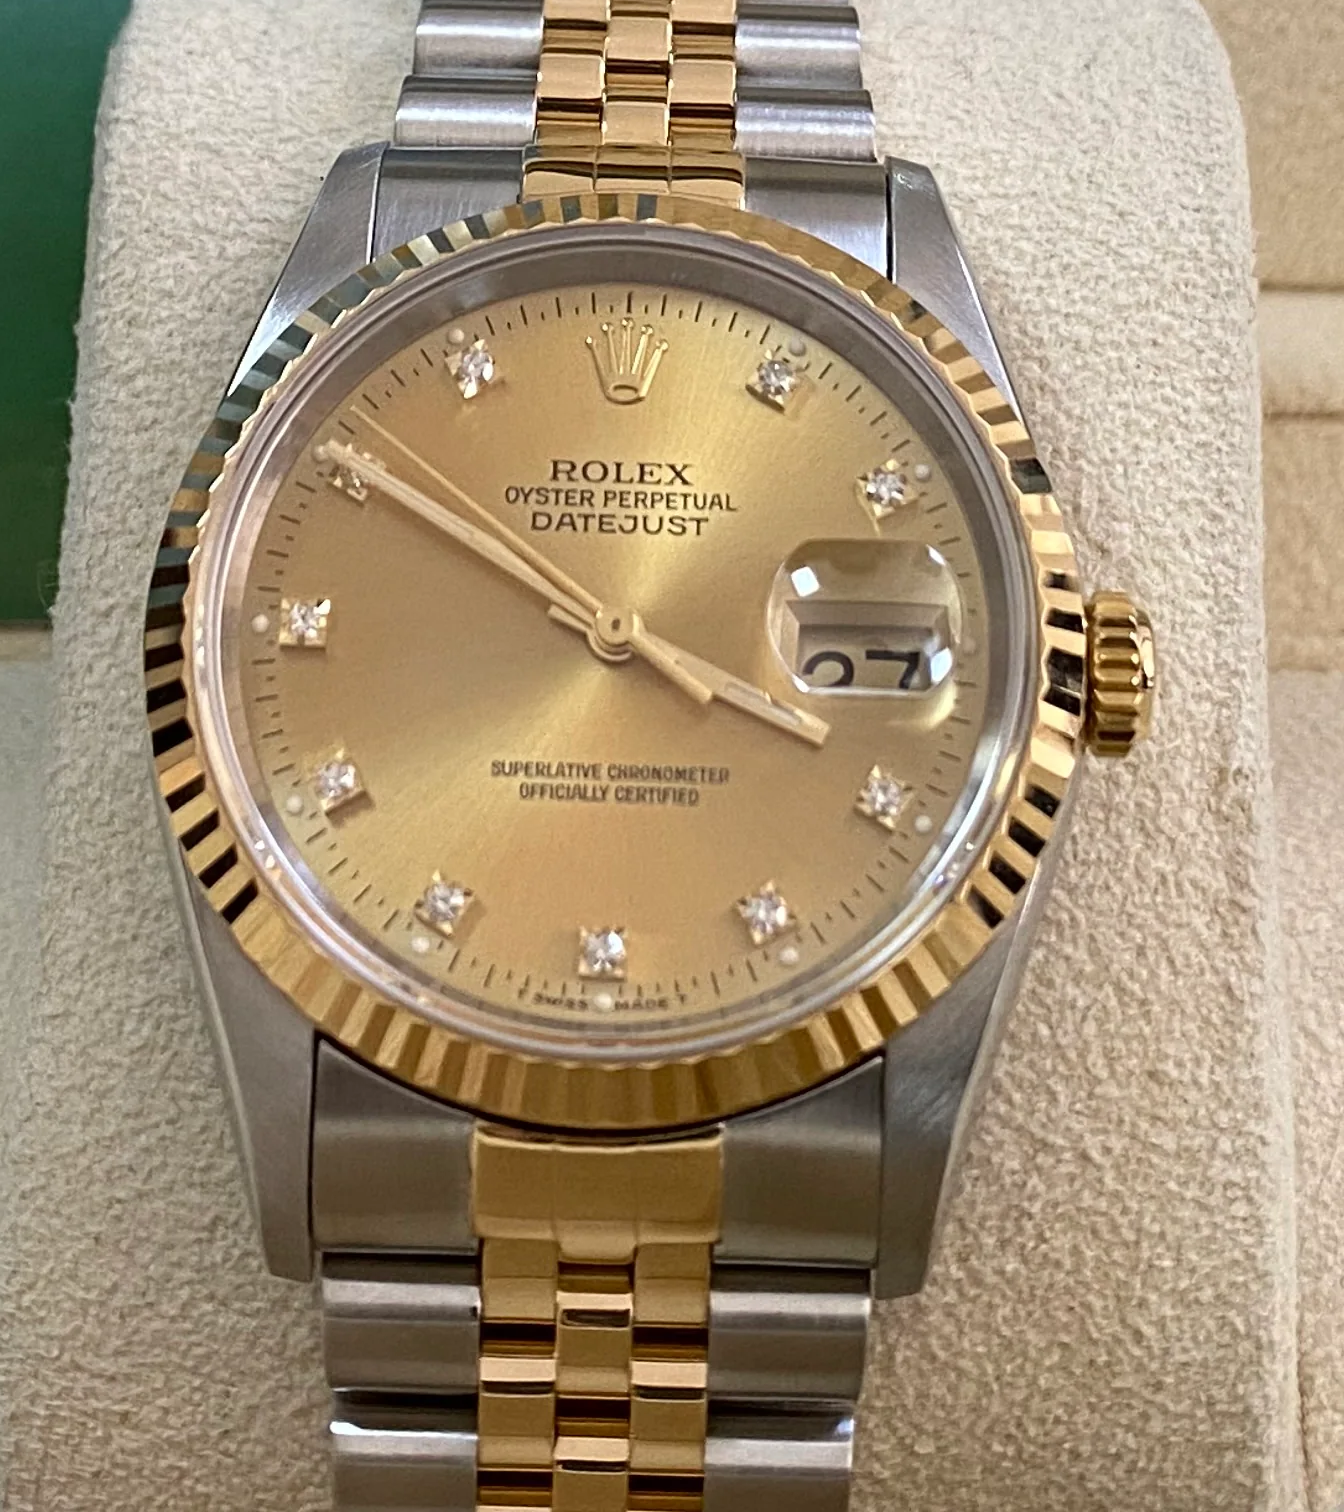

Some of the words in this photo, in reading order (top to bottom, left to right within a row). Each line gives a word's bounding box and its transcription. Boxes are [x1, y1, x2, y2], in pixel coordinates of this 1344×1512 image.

[550, 459, 692, 486] ROLEX
[505, 485, 594, 508] OYSTER
[603, 489, 737, 512] PERPETUAL
[530, 511, 709, 536] DATEJUST
[491, 759, 601, 780] SUPERLATIVE
[607, 762, 730, 784] CHRONOMETER
[519, 782, 608, 802] OFFICIALLY
[614, 785, 699, 806] CERTIFIED
